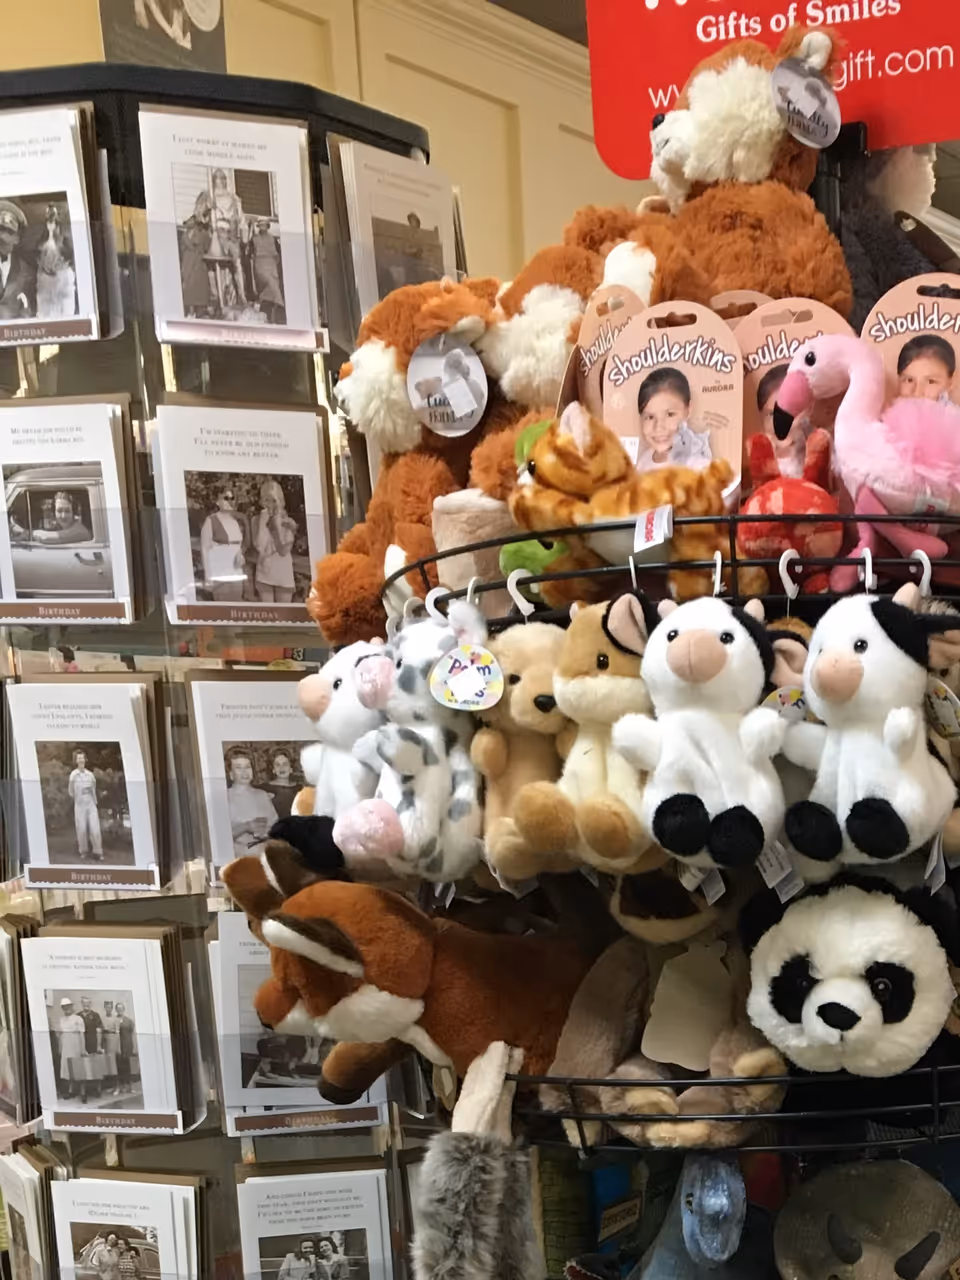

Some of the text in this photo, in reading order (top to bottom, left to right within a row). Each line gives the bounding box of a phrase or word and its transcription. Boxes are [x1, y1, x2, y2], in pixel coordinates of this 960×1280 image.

[696, 0, 902, 43] Gifts of Smiles
[4, 327, 46, 338] BIRTHDAY
[608, 333, 737, 386] shoulderkins
[38, 606, 81, 616] BIRTHDAY
[230, 608, 279, 620] BIRTHDAY
[70, 871, 112, 882] BIRTHDAY
[95, 1116, 136, 1126] BIRTHDAY
